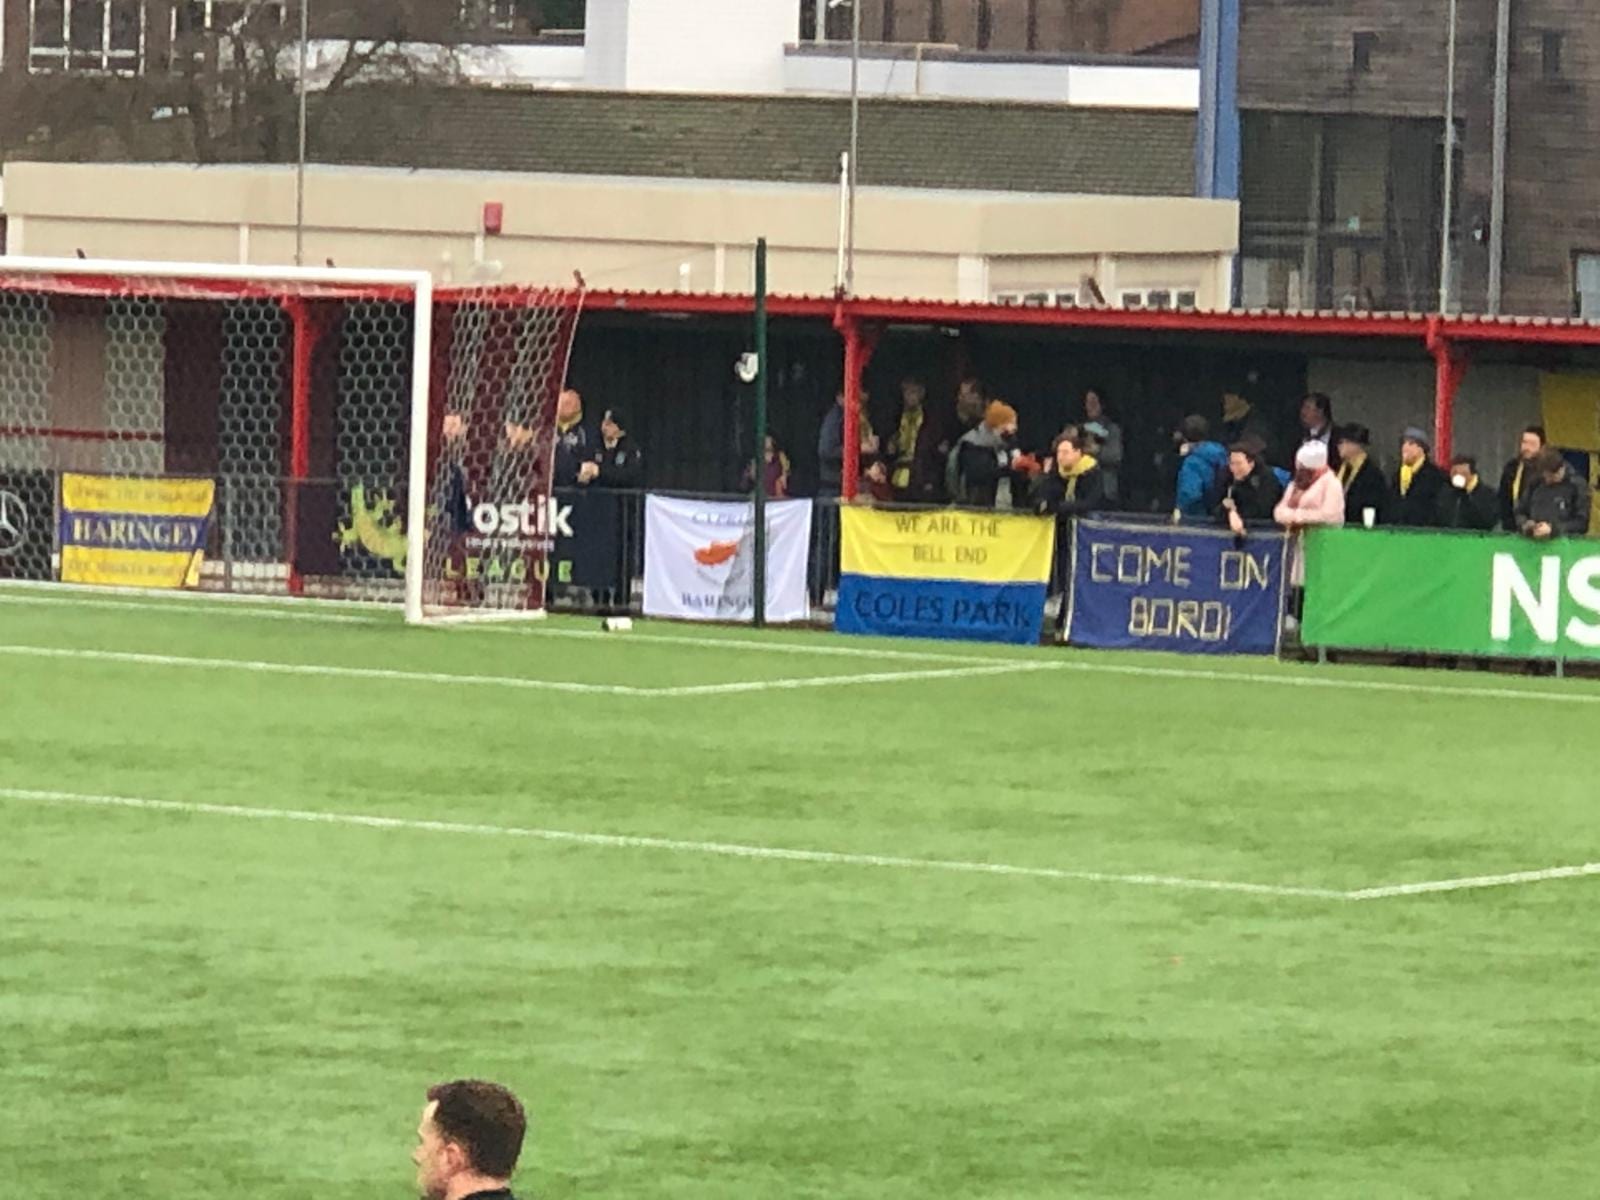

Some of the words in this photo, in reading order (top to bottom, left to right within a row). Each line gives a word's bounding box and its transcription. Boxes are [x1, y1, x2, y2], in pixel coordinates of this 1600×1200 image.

[465, 494, 574, 538] ostik
[895, 514, 921, 534] WE
[927, 515, 961, 535] ARE
[968, 516, 1001, 538] THE
[73, 517, 198, 546] HARINGEY
[445, 556, 573, 583] LEAGUE
[912, 544, 945, 563] BELL
[955, 546, 988, 566] END
[1090, 542, 1192, 589] COME
[1220, 550, 1270, 591] ON
[854, 590, 944, 623] COLES
[951, 595, 1031, 628] PARK
